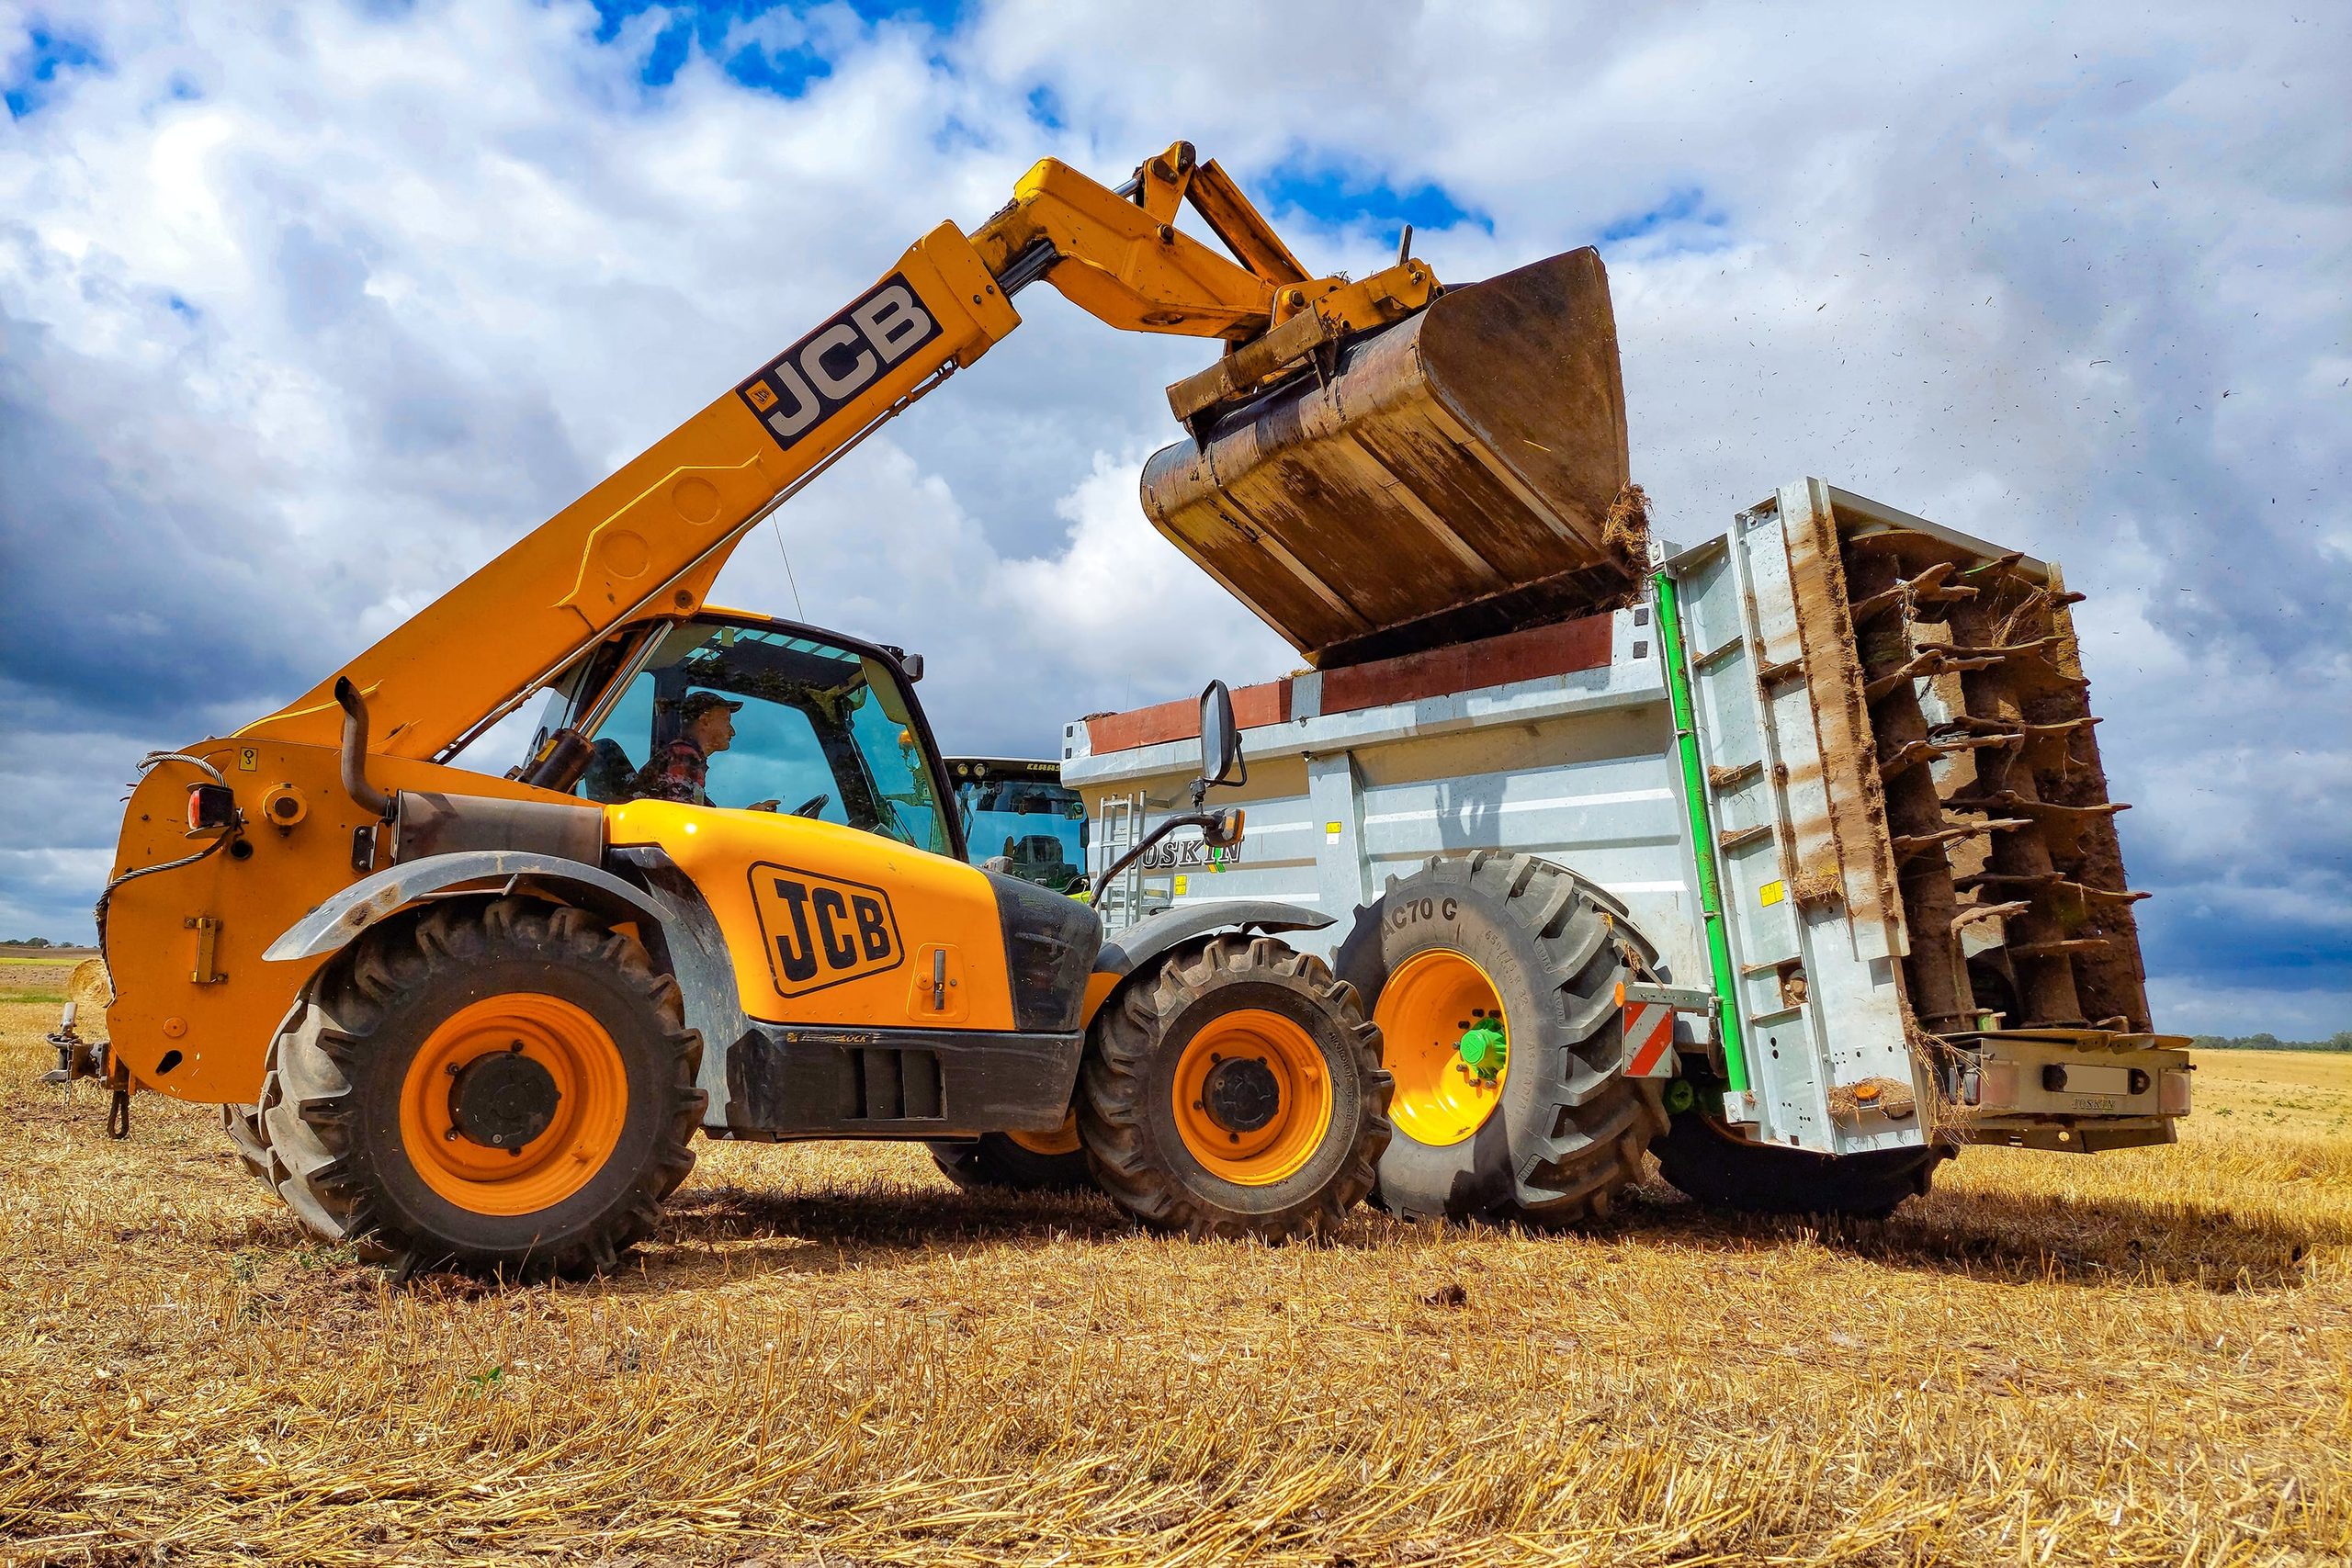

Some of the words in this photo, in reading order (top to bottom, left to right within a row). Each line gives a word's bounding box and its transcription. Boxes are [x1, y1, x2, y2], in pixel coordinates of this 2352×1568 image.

[768, 285, 932, 436] JCB
[752, 389, 770, 403] JCB
[1130, 835, 1244, 869] OSKIN
[774, 878, 891, 982] JCB
[2071, 1097, 2116, 1111] JOSKIN
